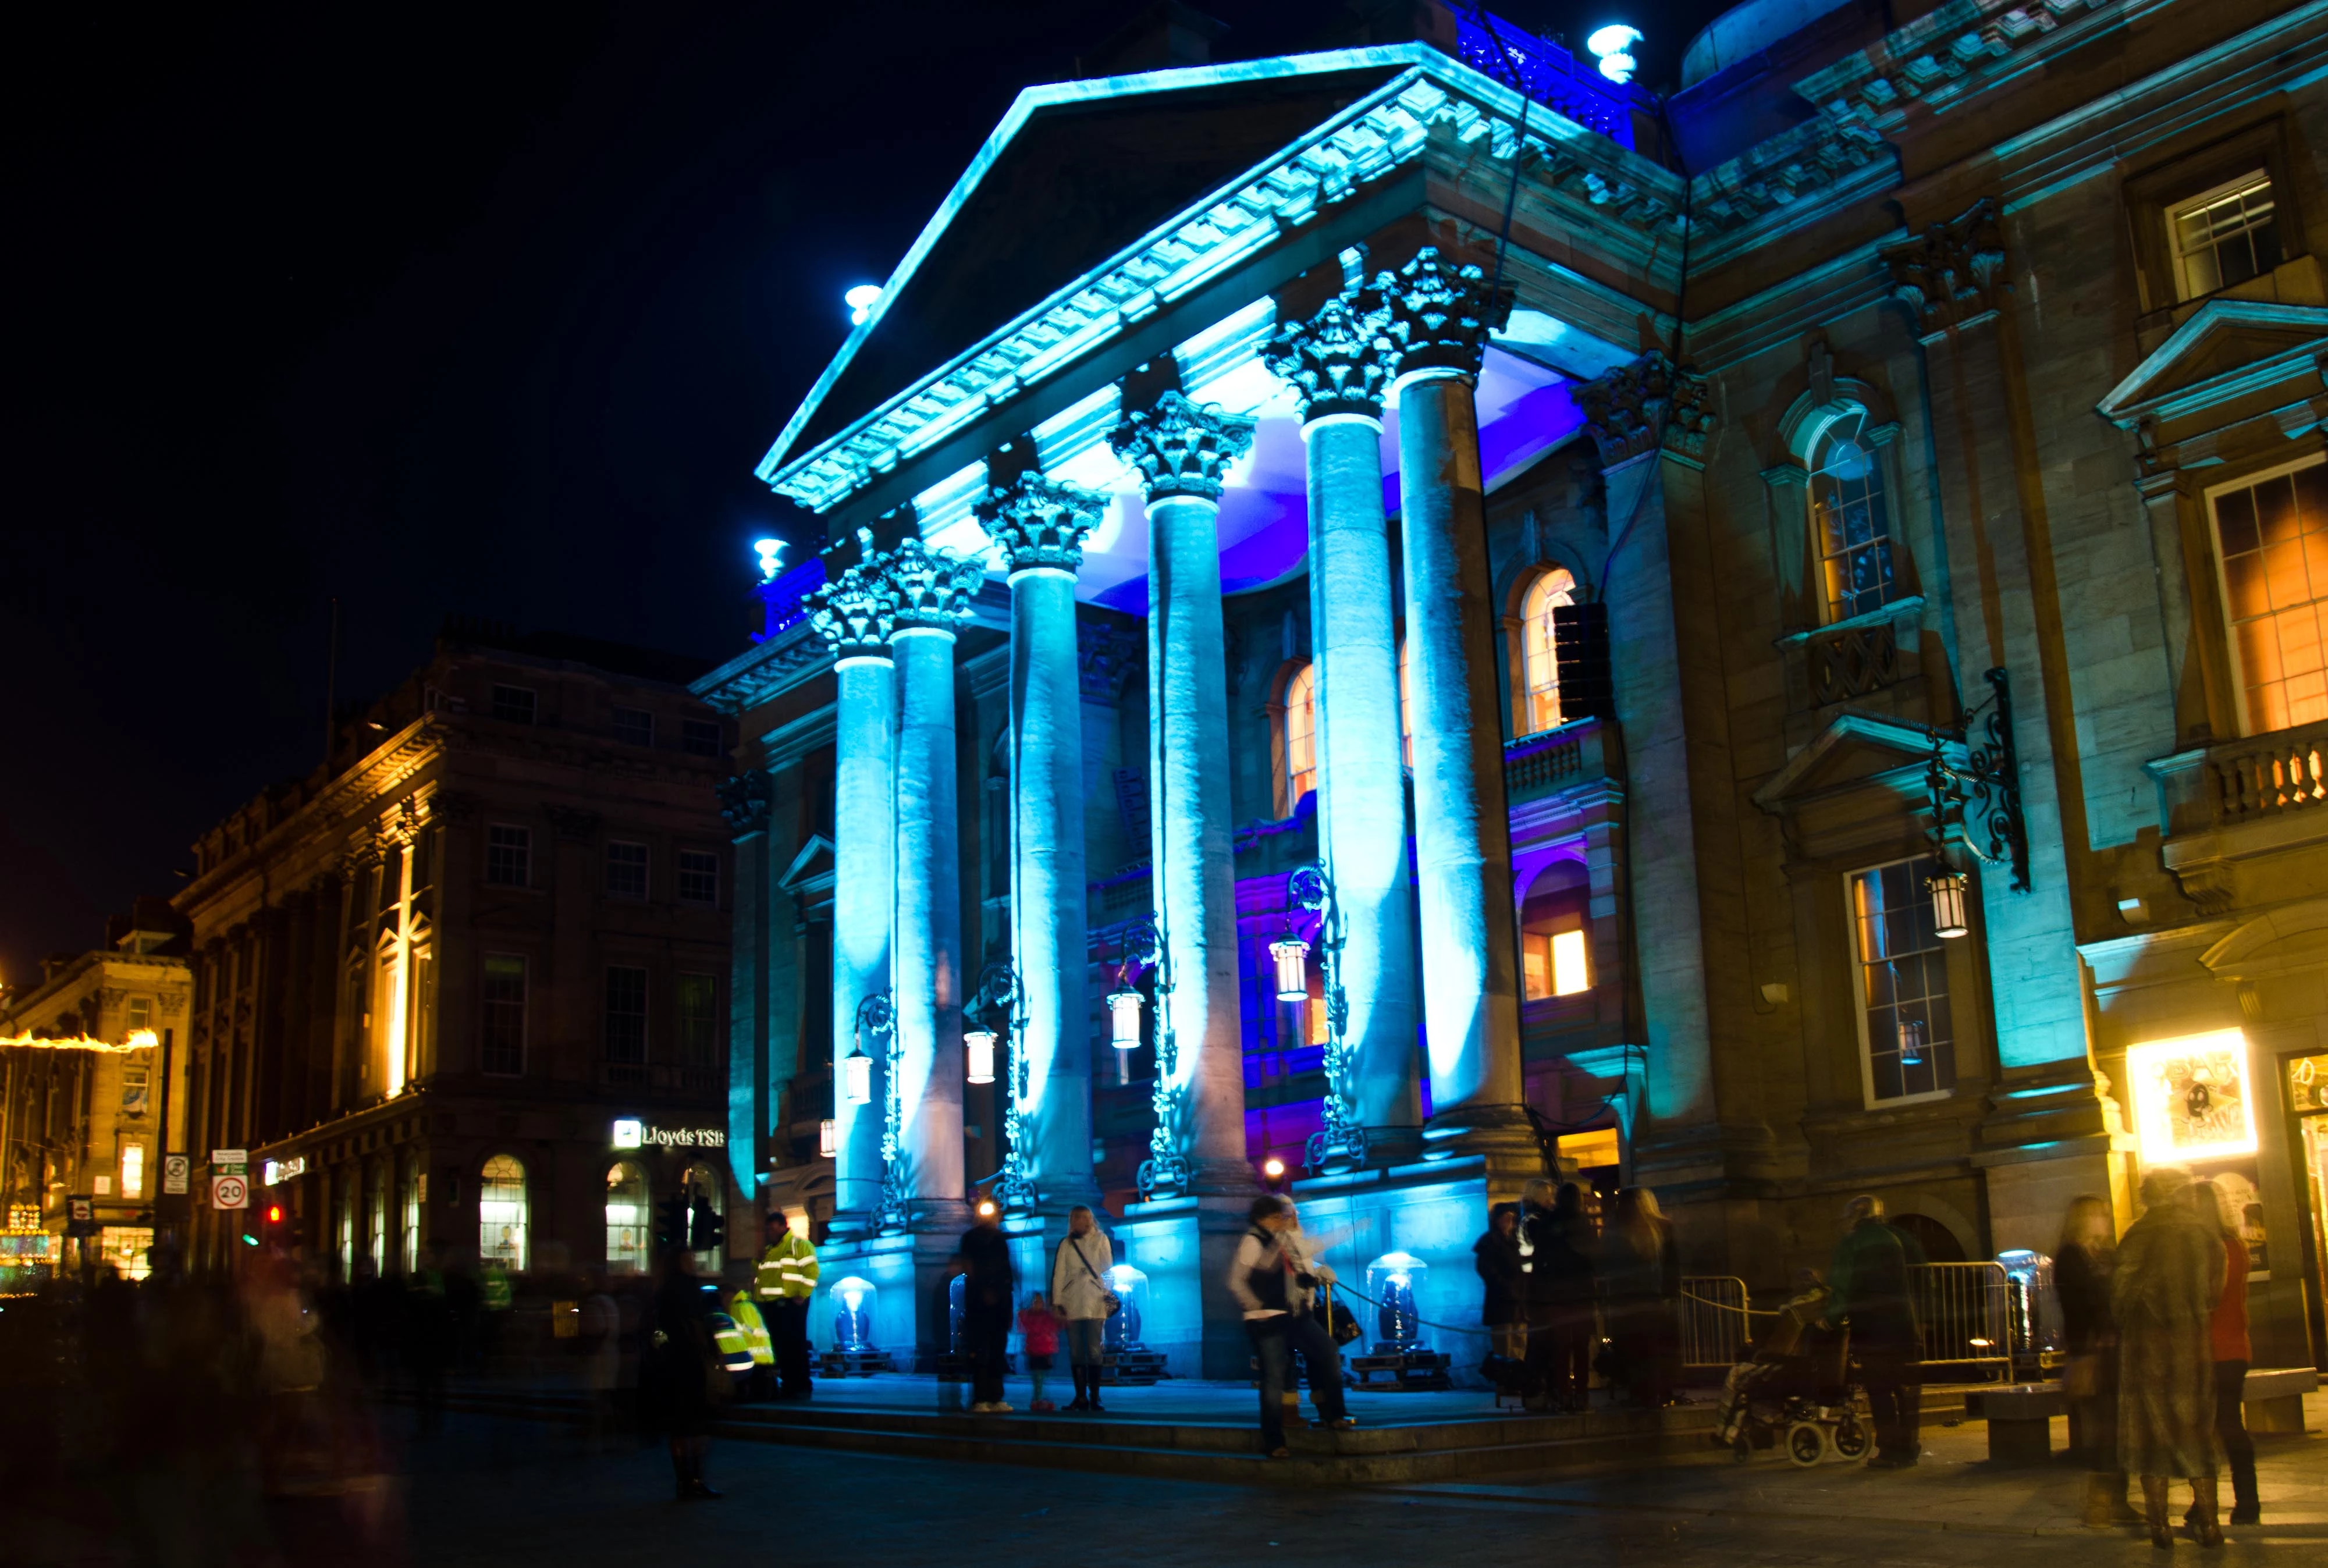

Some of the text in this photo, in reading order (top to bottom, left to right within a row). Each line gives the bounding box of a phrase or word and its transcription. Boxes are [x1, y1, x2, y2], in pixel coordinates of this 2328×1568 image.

[642, 1126, 725, 1147] Lloyds TSB
[221, 1186, 241, 1199] 20
